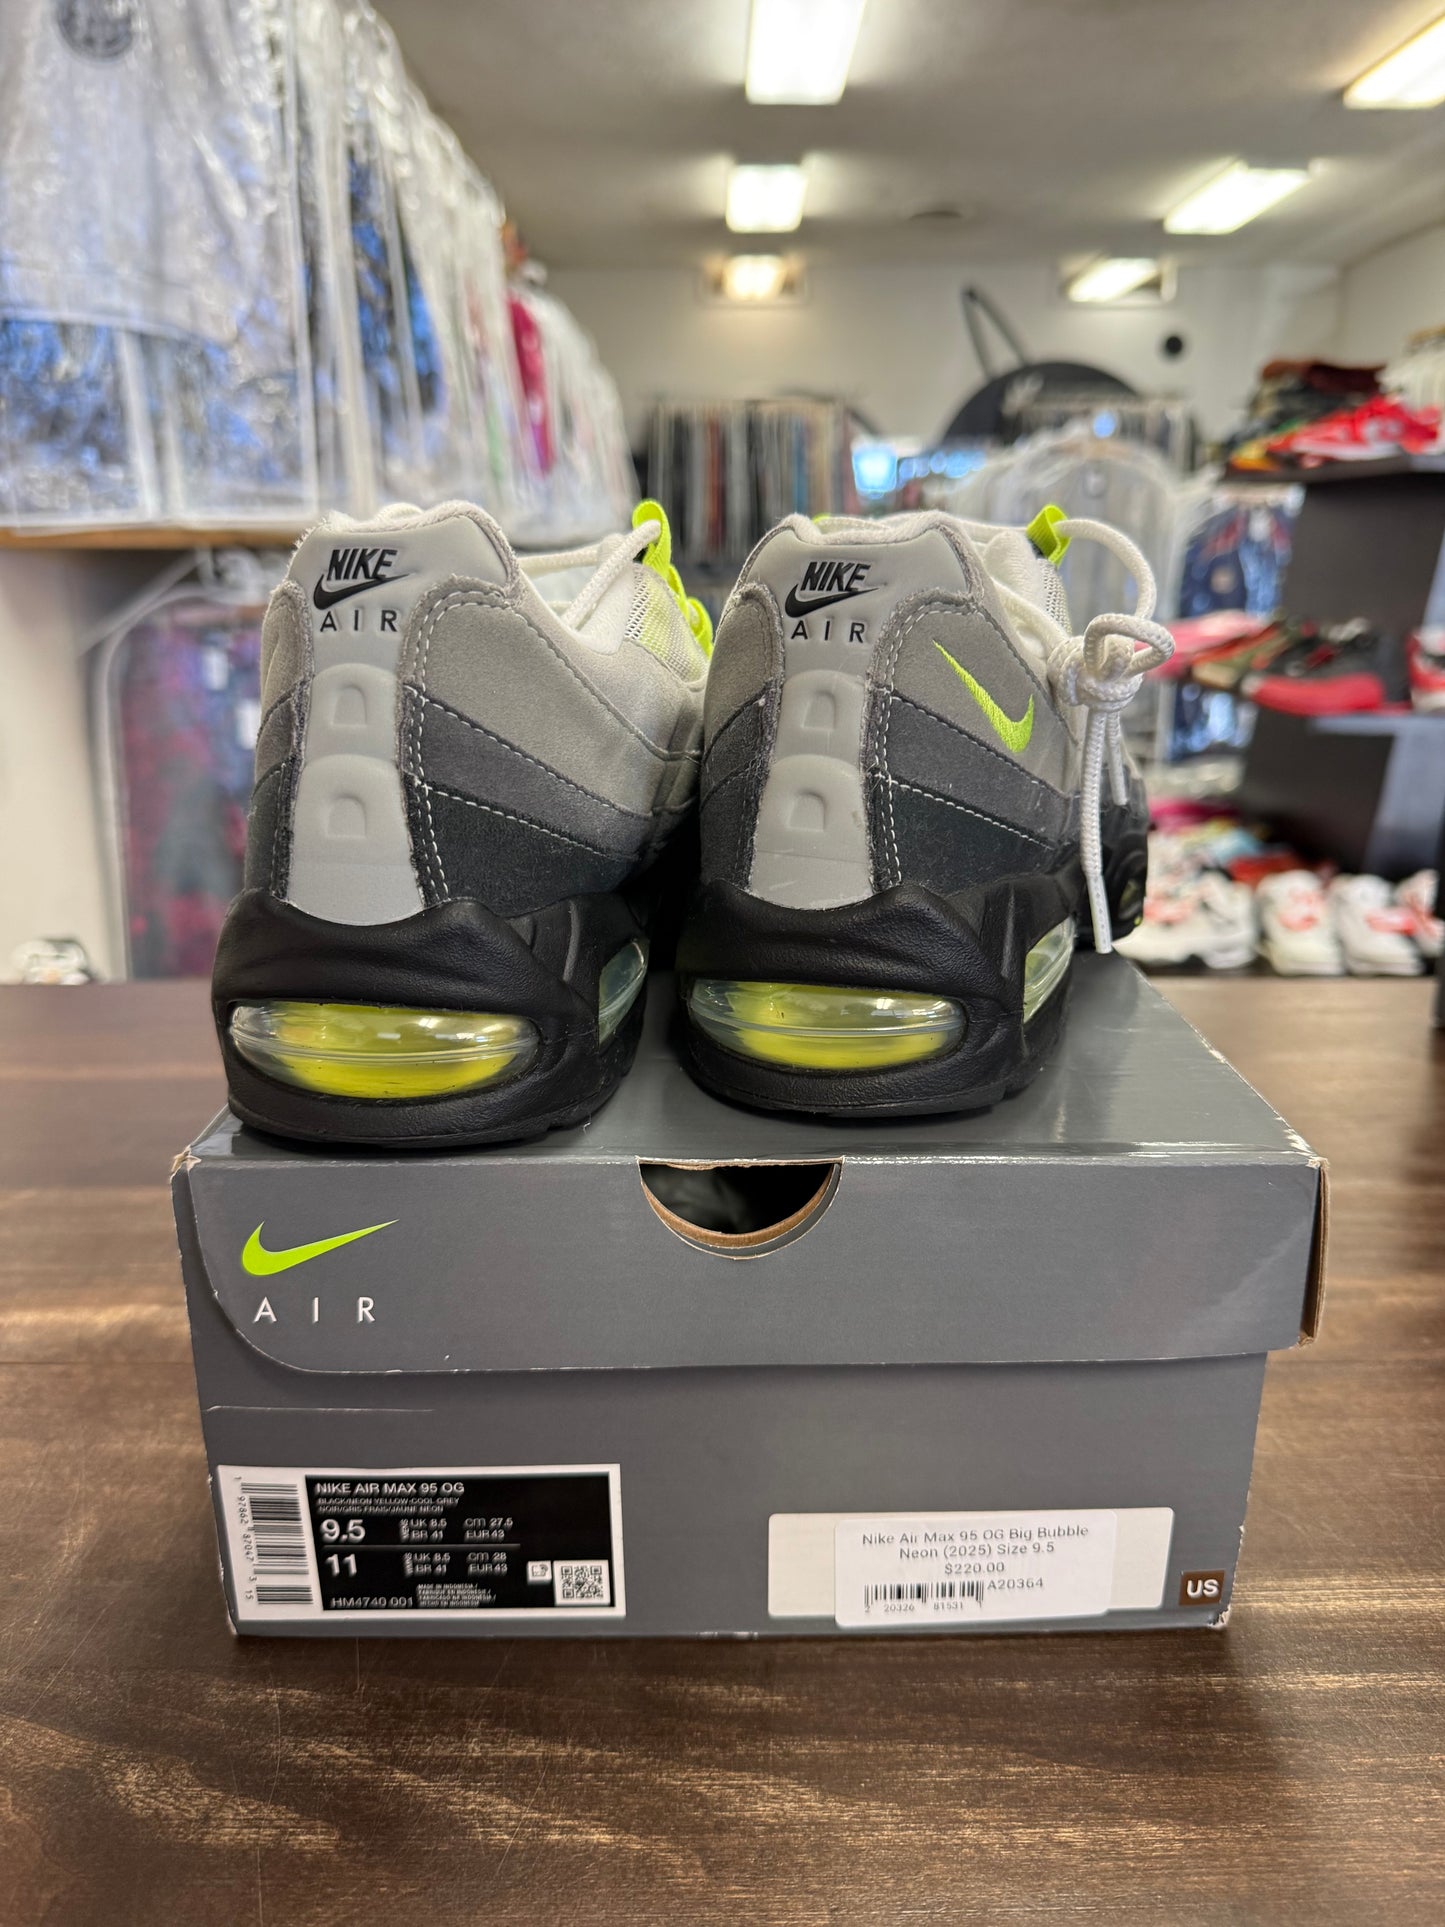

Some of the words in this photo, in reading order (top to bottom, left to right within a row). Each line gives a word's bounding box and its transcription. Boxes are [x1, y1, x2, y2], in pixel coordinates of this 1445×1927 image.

[327, 549, 398, 581] NIKE
[800, 562, 871, 592] NIKE
[320, 609, 398, 633] AIR
[791, 620, 864, 643] AIR
[253, 1296, 376, 1324] AIR
[316, 1482, 352, 1494] NIKE
[354, 1482, 380, 1494] AIR
[383, 1482, 417, 1494] MAX
[420, 1482, 438, 1494] 95
[441, 1481, 465, 1494] OG
[237, 1495, 249, 1524] 97862
[321, 1518, 366, 1542] 9.5
[409, 1518, 428, 1528] UK
[429, 1518, 447, 1528] 8.5
[488, 1517, 514, 1528] 27.5
[412, 1529, 428, 1540] BR
[431, 1529, 443, 1540] 41
[465, 1529, 490, 1540] EUR
[491, 1529, 505, 1540] 43
[862, 1533, 895, 1545] Nike
[899, 1532, 918, 1544] Air
[923, 1531, 954, 1543] Max
[959, 1530, 978, 1542] 95
[983, 1529, 1004, 1541] OG
[1009, 1528, 1032, 1541] Big
[1037, 1525, 1089, 1539] Bubble
[413, 1552, 431, 1561] UK
[433, 1552, 451, 1561] 8.5
[492, 1551, 507, 1561] 28
[899, 1547, 938, 1559] Neon
[943, 1543, 992, 1558] (2025)
[997, 1543, 1027, 1555] Size
[1032, 1541, 1055, 1554] 9.5
[325, 1553, 357, 1576] 11
[416, 1563, 432, 1573] BR
[434, 1563, 447, 1573] 41
[469, 1563, 493, 1573] EUR
[494, 1563, 508, 1573] 43
[944, 1562, 1005, 1575] $220.00
[987, 1578, 1044, 1590] A20364
[1186, 1578, 1219, 1598] US
[245, 1590, 255, 1600] 15
[331, 1596, 387, 1607] HM4740
[389, 1596, 413, 1607] 001
[933, 1602, 964, 1611] 81531
